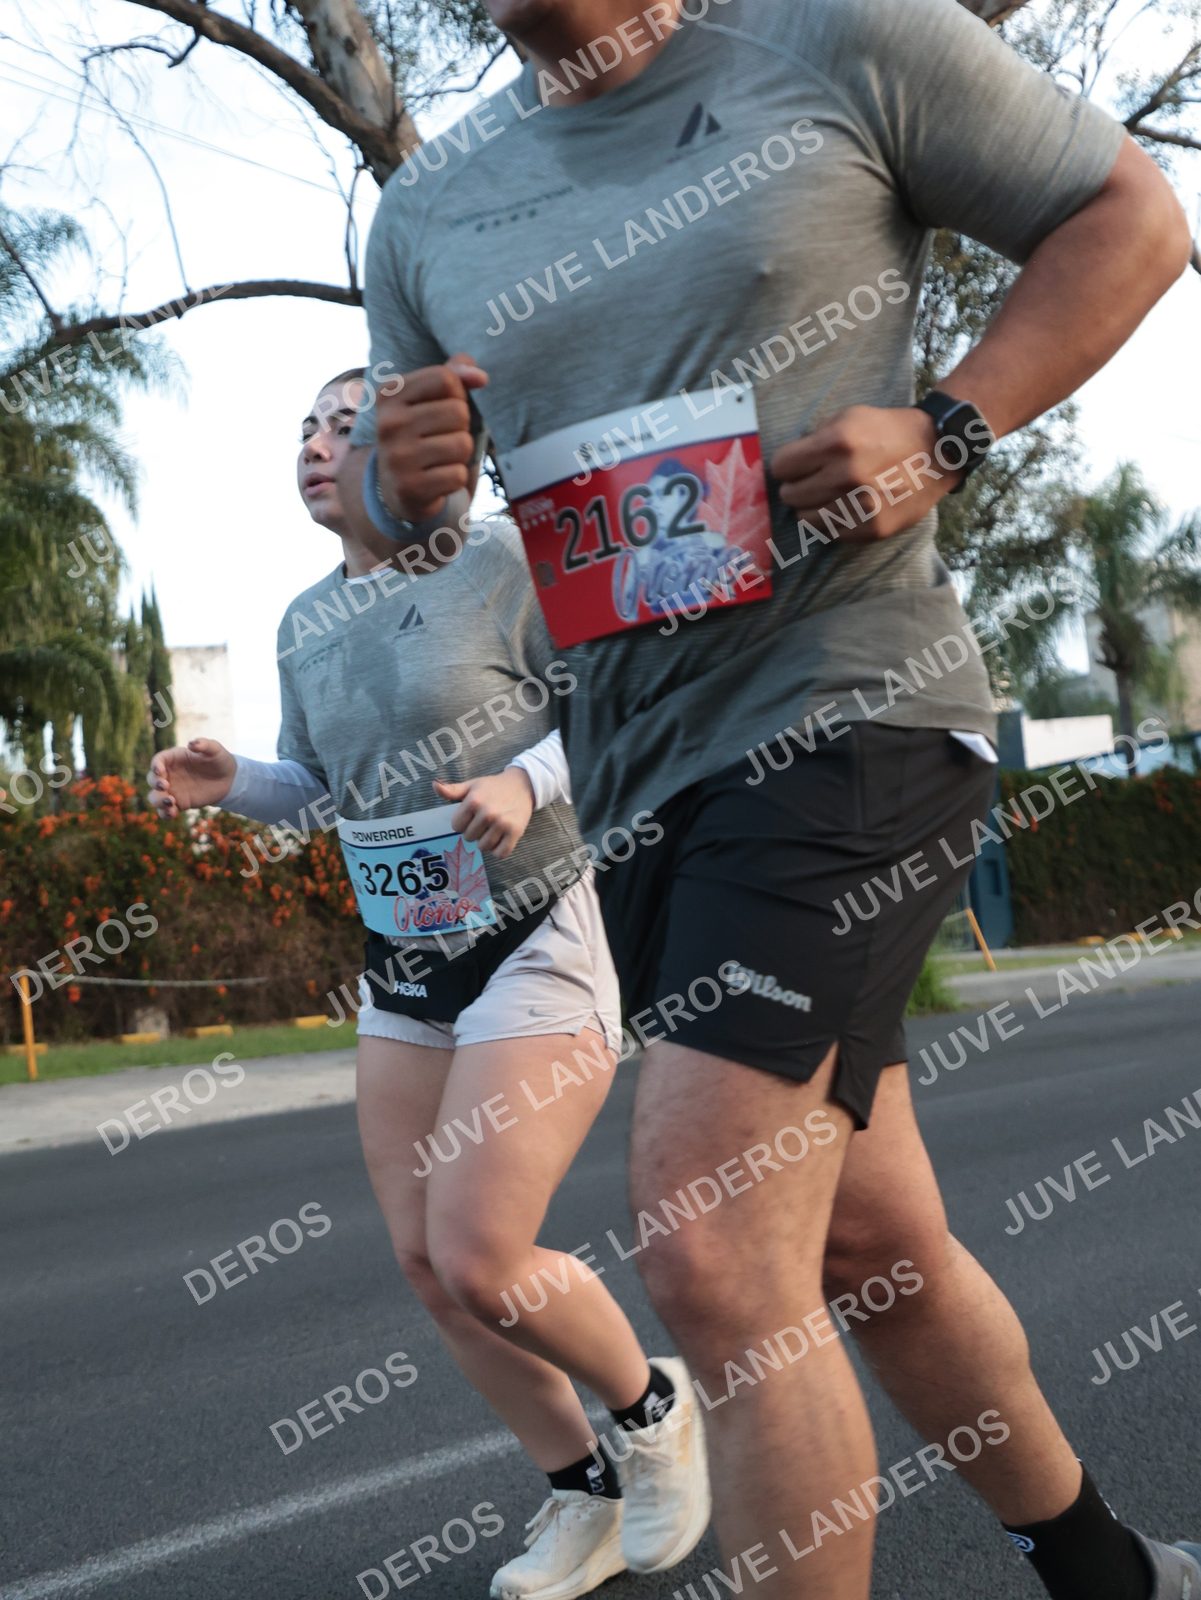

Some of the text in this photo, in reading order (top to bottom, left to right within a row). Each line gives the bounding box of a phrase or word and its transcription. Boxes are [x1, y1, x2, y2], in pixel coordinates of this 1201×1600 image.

[555, 473, 705, 573] 2162
[352, 826, 414, 842] POWERADE
[359, 855, 449, 896] 3265
[394, 981, 428, 998] HOKA
